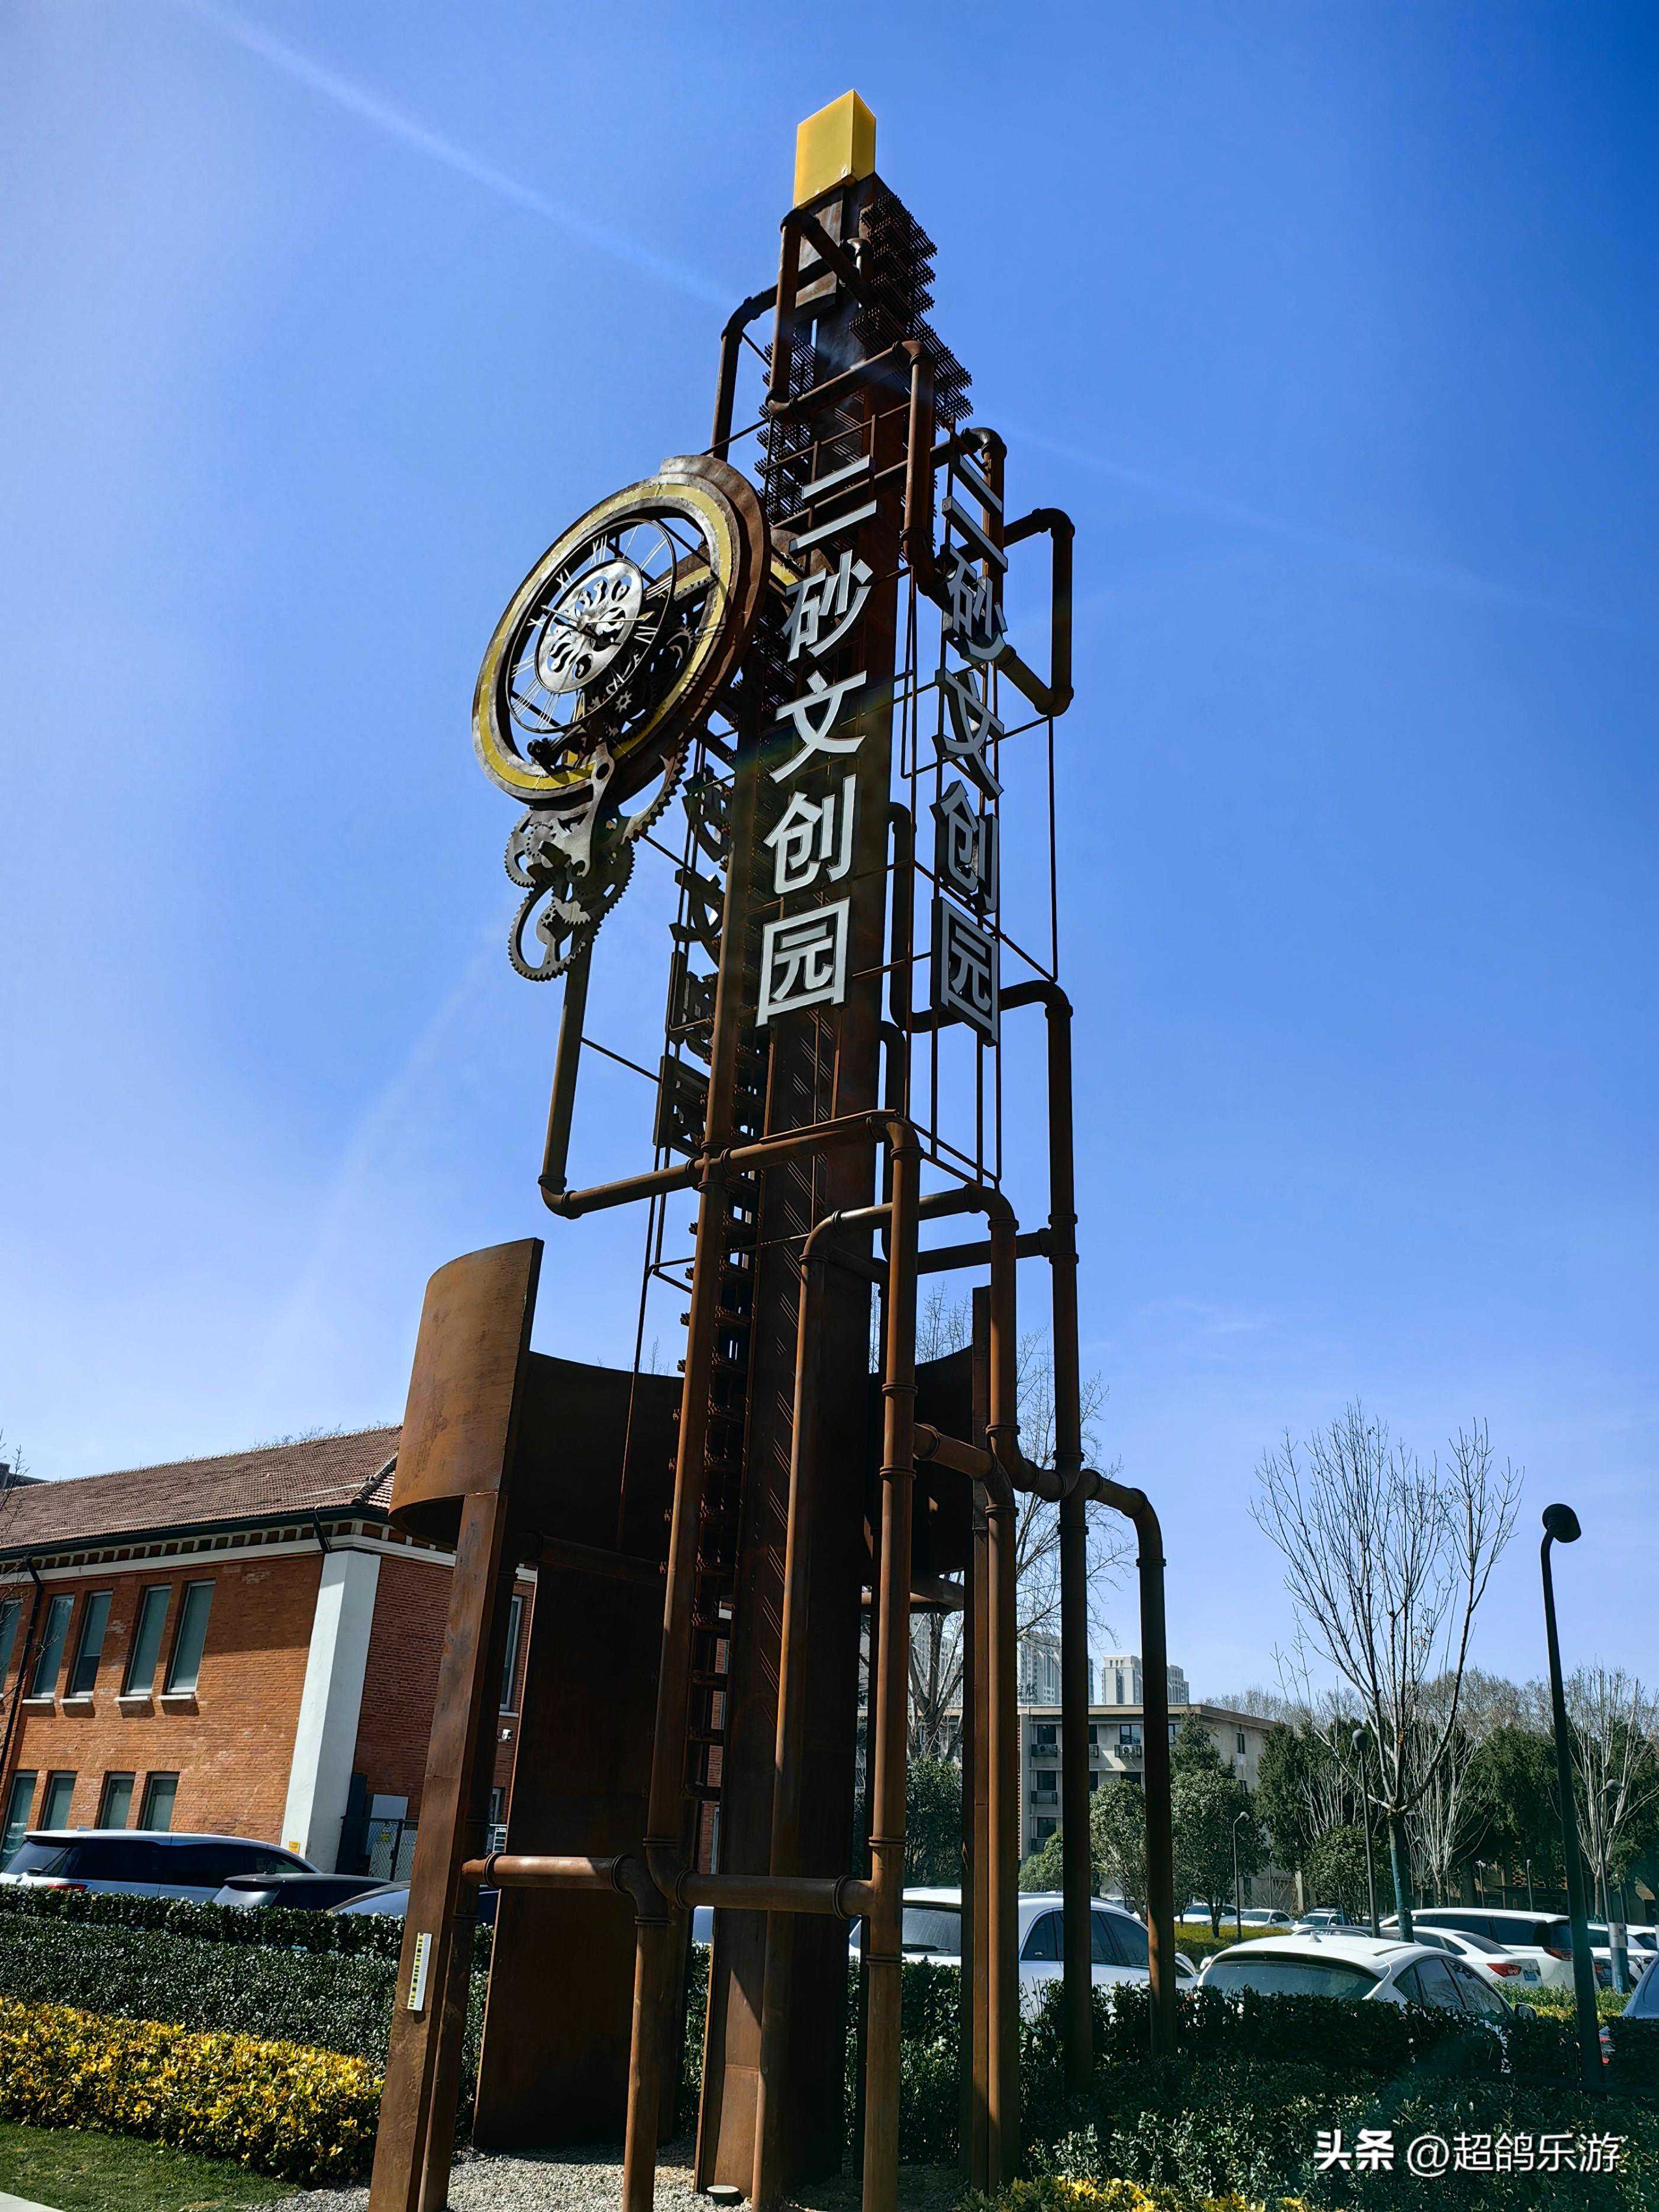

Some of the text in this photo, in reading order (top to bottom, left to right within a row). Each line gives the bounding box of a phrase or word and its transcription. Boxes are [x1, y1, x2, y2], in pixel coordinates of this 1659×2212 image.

[756, 454, 879, 1027] 二砂文创园
[934, 453, 1008, 1045] 二砂文创园
